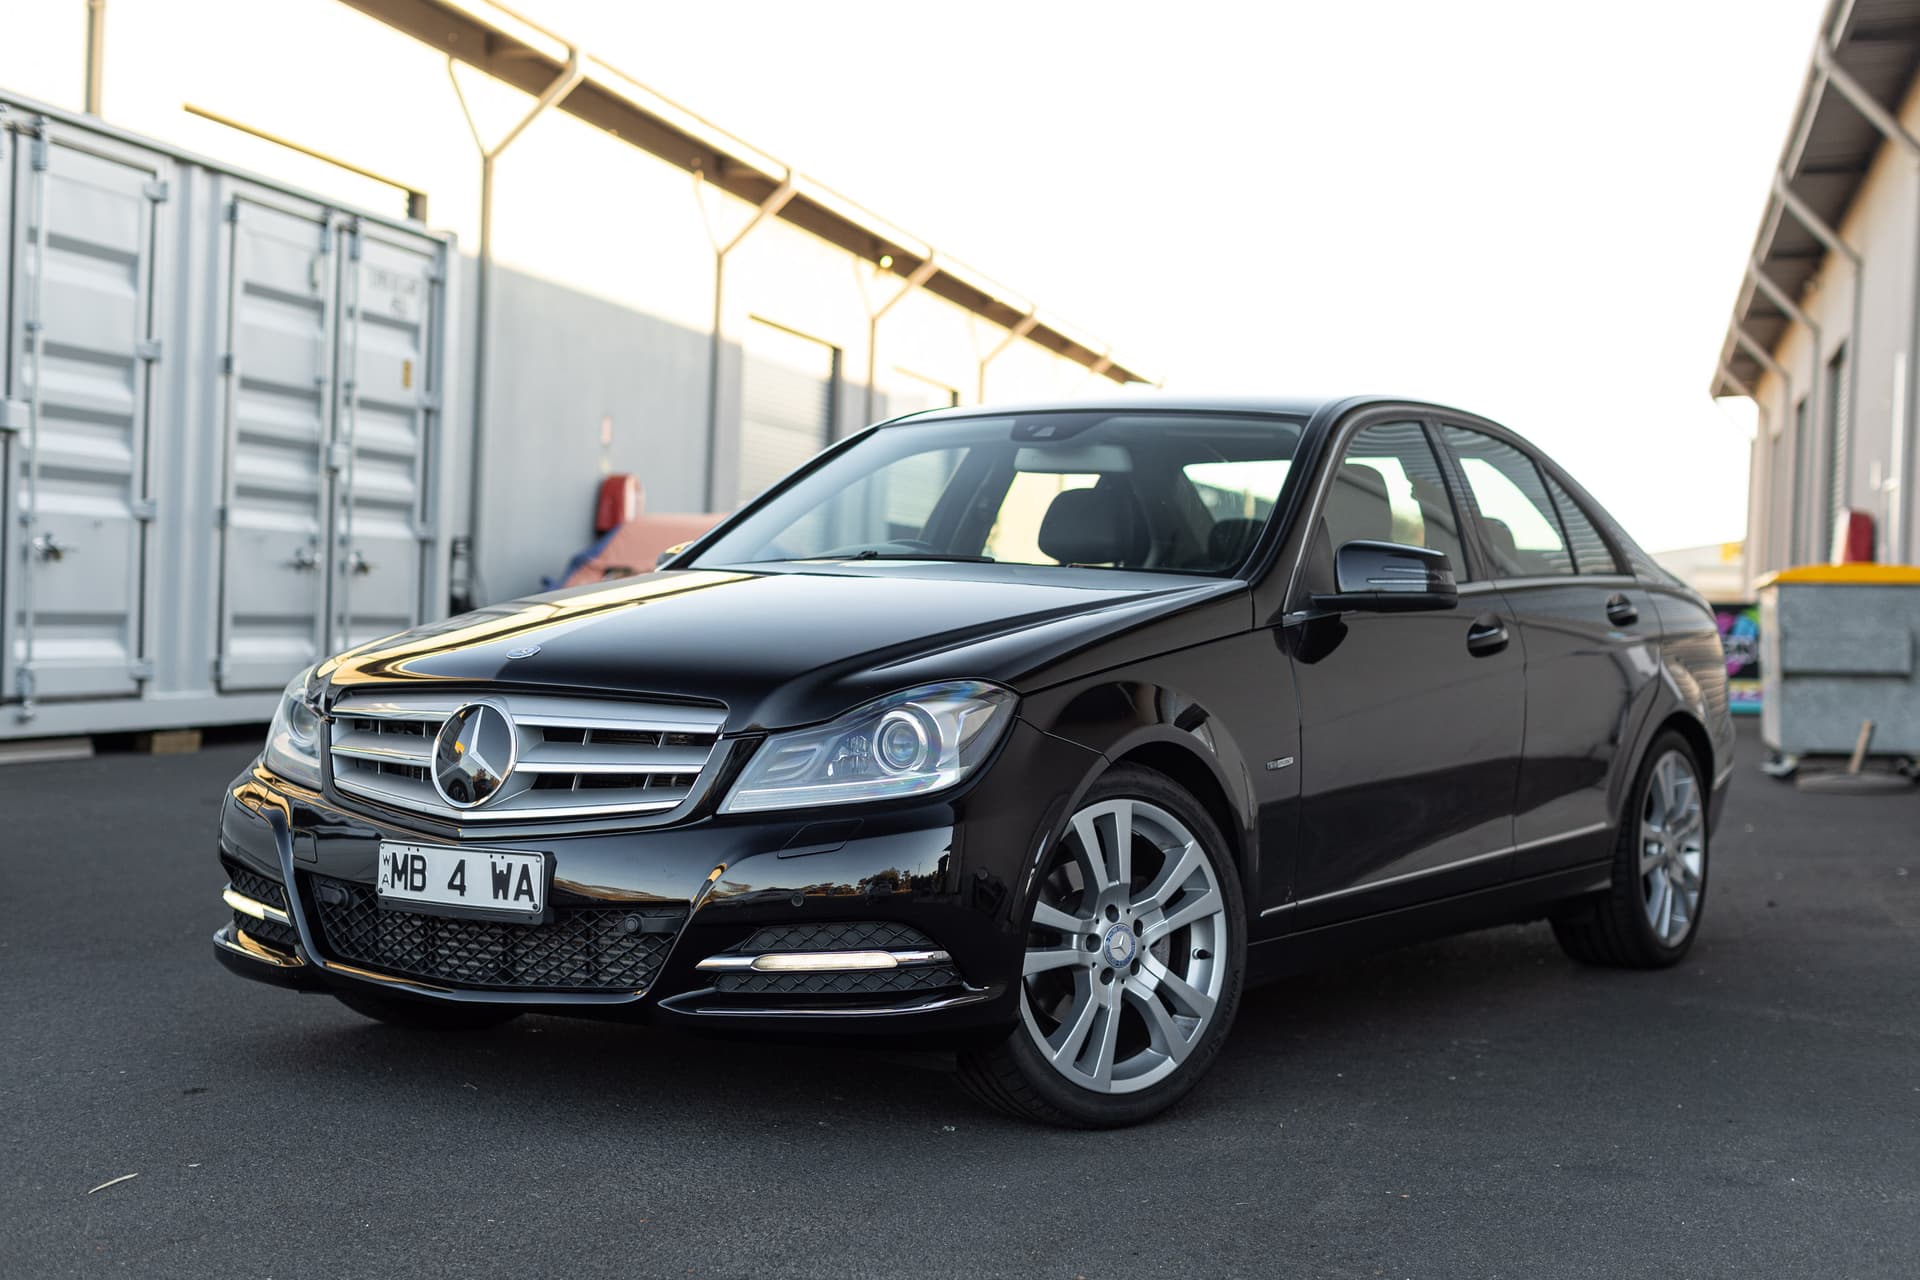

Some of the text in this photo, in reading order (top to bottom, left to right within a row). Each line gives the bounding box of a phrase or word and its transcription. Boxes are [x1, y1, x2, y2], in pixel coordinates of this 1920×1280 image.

[391, 852, 535, 902] MB 4 WA
